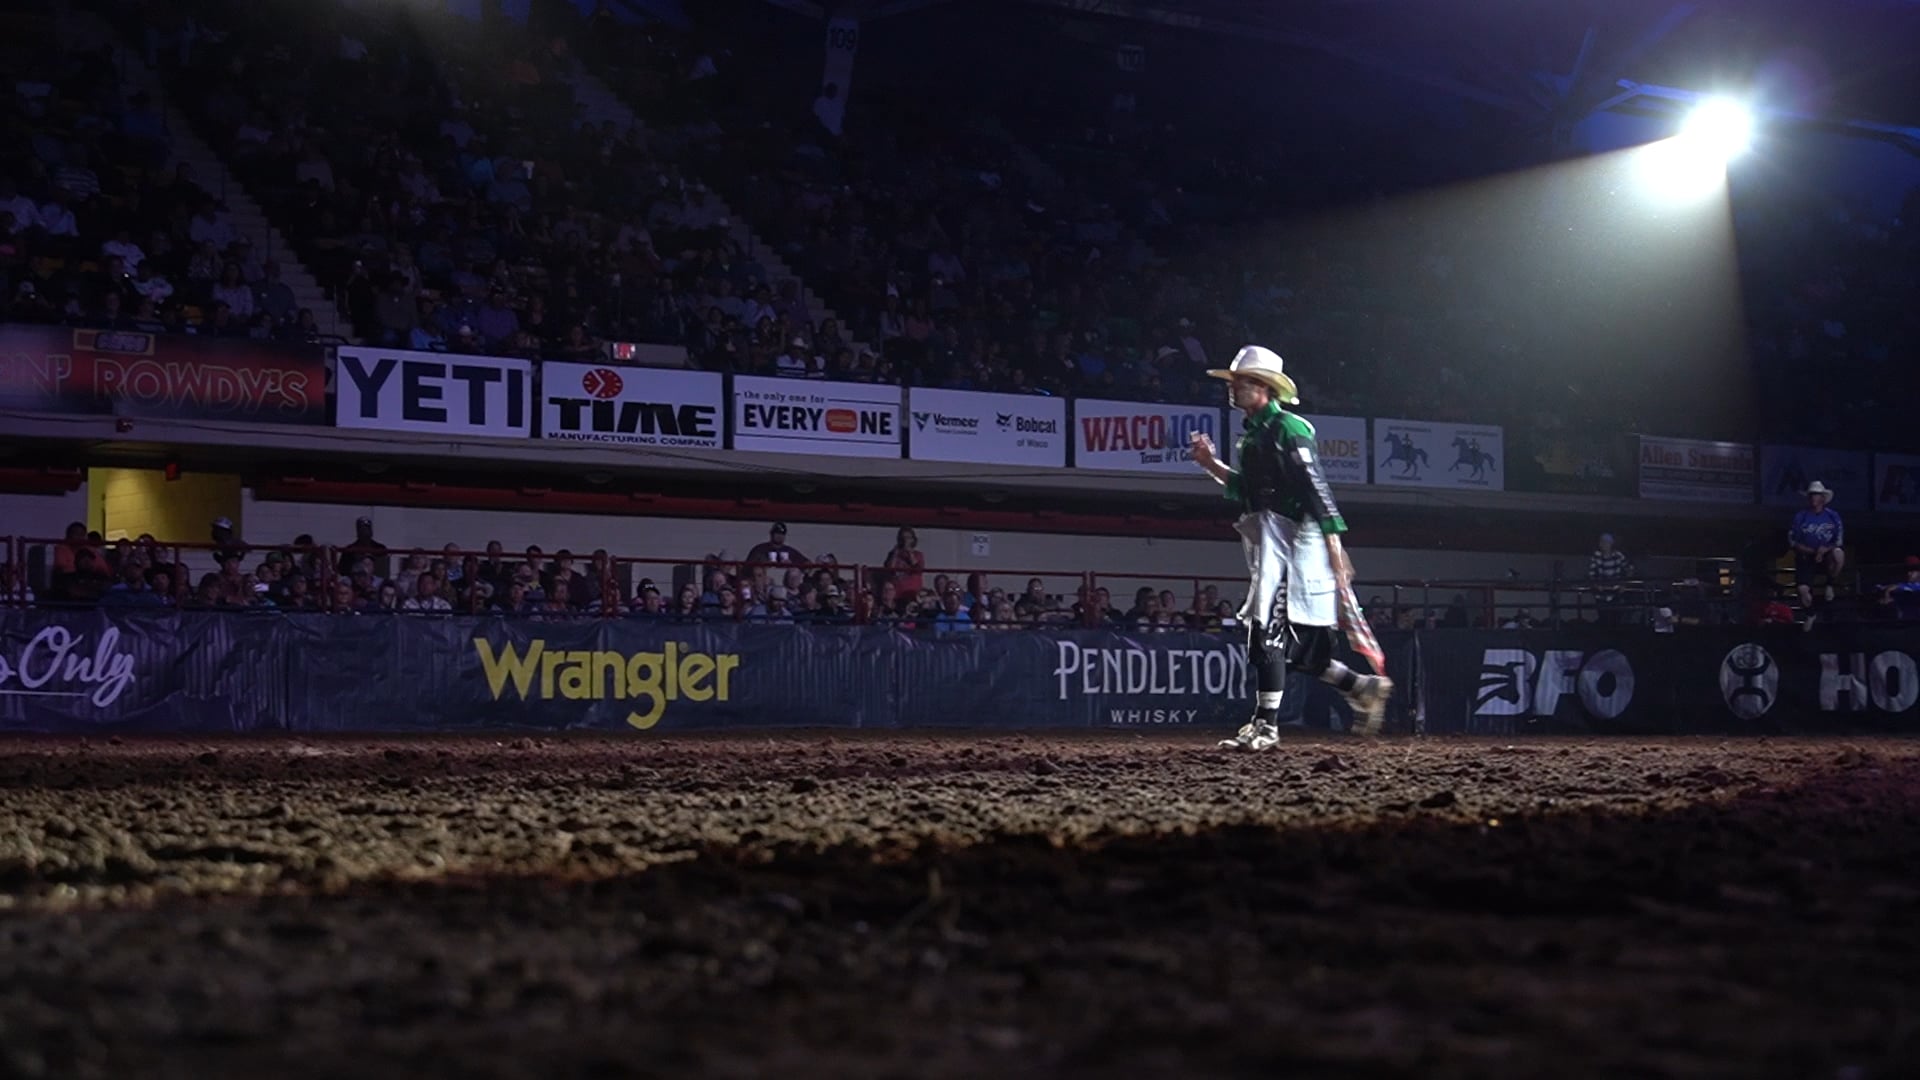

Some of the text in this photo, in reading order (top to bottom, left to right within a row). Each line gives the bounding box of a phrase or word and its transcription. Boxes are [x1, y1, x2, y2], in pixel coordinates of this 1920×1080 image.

[94, 358, 309, 418] ROWDY'S
[339, 356, 524, 428] YETI
[744, 391, 825, 404] the only one for
[548, 397, 716, 438] TIME
[933, 413, 980, 428] Vermeer
[1016, 416, 1057, 434] Bobcat
[1081, 415, 1165, 452] WACO
[548, 432, 718, 448] MANUFACTURING COMPANY
[19, 625, 135, 707] Only
[473, 637, 740, 730] Wrangler
[1053, 640, 1248, 699] PENDLETON
[1110, 708, 1198, 723] WHISKY
